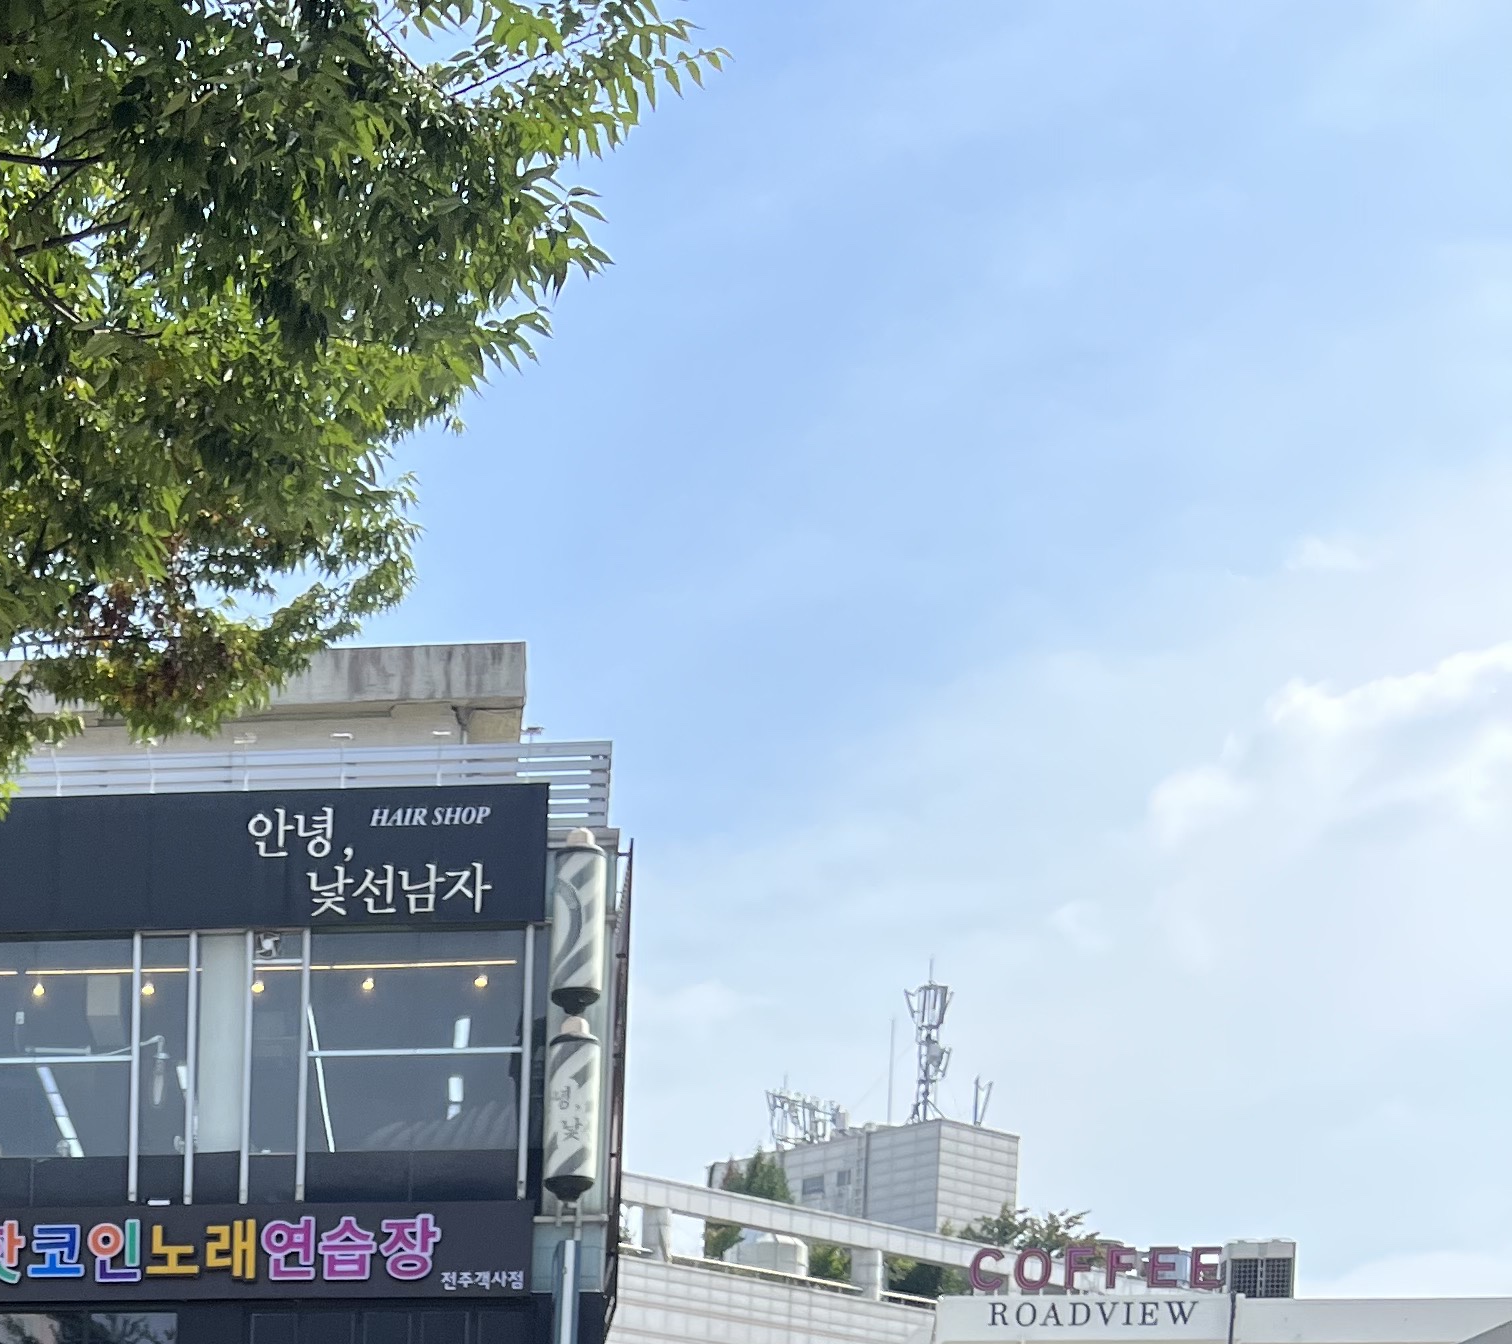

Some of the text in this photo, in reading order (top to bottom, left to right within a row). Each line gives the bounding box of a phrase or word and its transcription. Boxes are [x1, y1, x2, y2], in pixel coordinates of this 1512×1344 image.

[247, 806, 355, 862] 안녕,
[370, 806, 492, 827] HAIR SHOP
[969, 1246, 1226, 1292] COFFEE
[988, 1301, 1199, 1327] ROADVIEW
